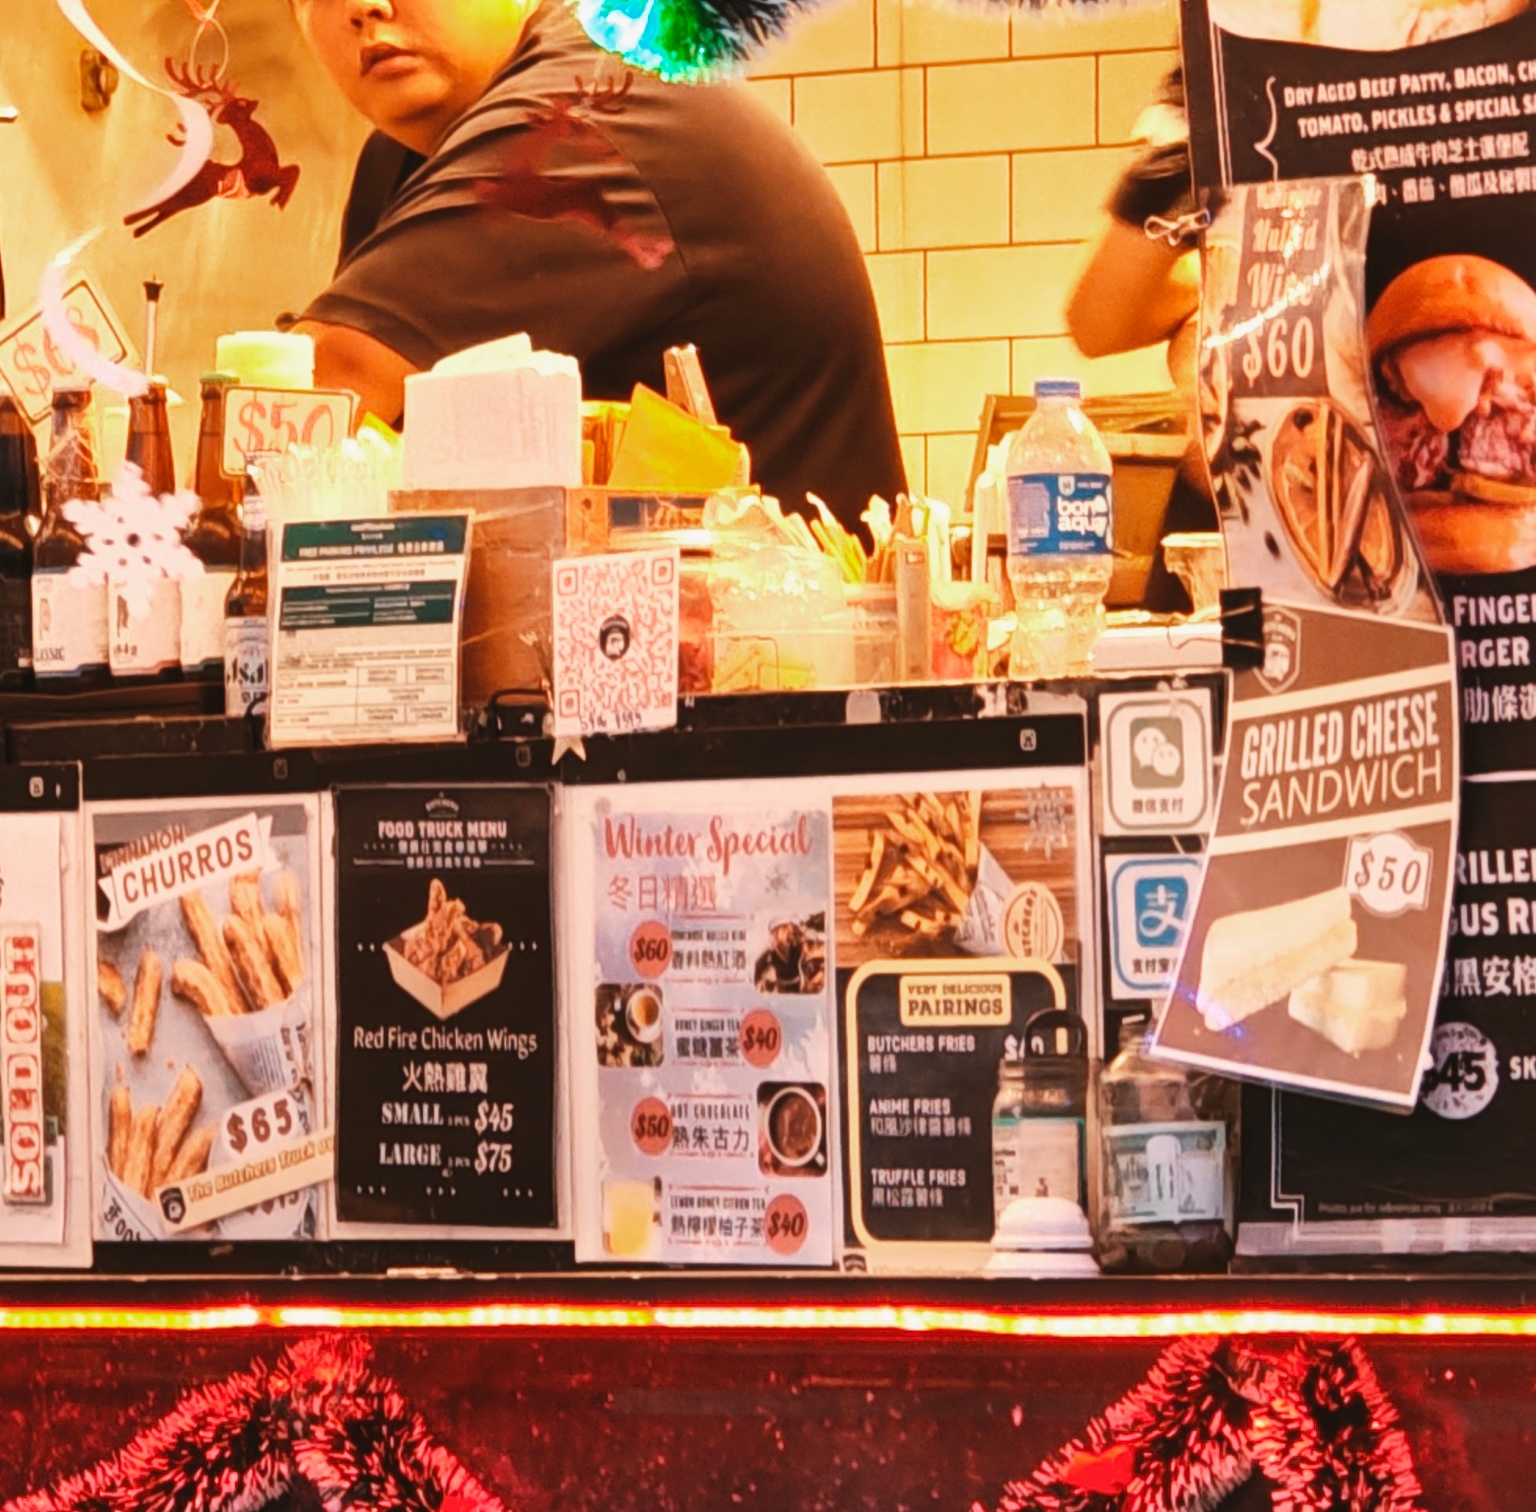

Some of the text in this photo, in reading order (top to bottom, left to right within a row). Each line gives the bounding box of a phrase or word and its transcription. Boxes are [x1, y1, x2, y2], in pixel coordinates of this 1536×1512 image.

[1284, 86, 1314, 108] DRY
[1317, 81, 1357, 104] AGED
[1360, 76, 1397, 99] BEEF
[1400, 71, 1452, 93] PATTY,
[1454, 63, 1515, 87] BACON,
[1298, 112, 1369, 138] TOMATO,
[1371, 104, 1437, 131] PICKLES
[1439, 102, 1452, 124] &
[1454, 95, 1521, 123] SPECIAL
[1242, 313, 1314, 387] $60
[234, 392, 334, 461] $50
[1241, 690, 1440, 780] GRILLED CHEESE
[1240, 749, 1442, 827] SANDWICH
[378, 821, 507, 839] FOOD TRUCK MENU
[605, 814, 811, 877] Winter Special
[122, 829, 253, 903] CHURROS
[1354, 849, 1421, 895] $50
[608, 874, 718, 911] 冬日精選
[1507, 897, 1536, 936] R
[634, 937, 669, 964] $60
[907, 999, 1003, 1016] PAIRINGS
[354, 1026, 537, 1060] Red Fire Chicken Wings
[743, 1025, 778, 1052] $40
[867, 1034, 976, 1052] BUTCHERS FRIES
[4, 937, 41, 1196] SOLD OUT
[226, 1099, 292, 1154] $65
[382, 1099, 514, 1136] SMALL $45
[635, 1114, 670, 1140] $50
[379, 1139, 513, 1176] LARGE $75
[871, 1169, 966, 1186] TRUFFLE FRIES
[768, 1210, 805, 1238] $40
